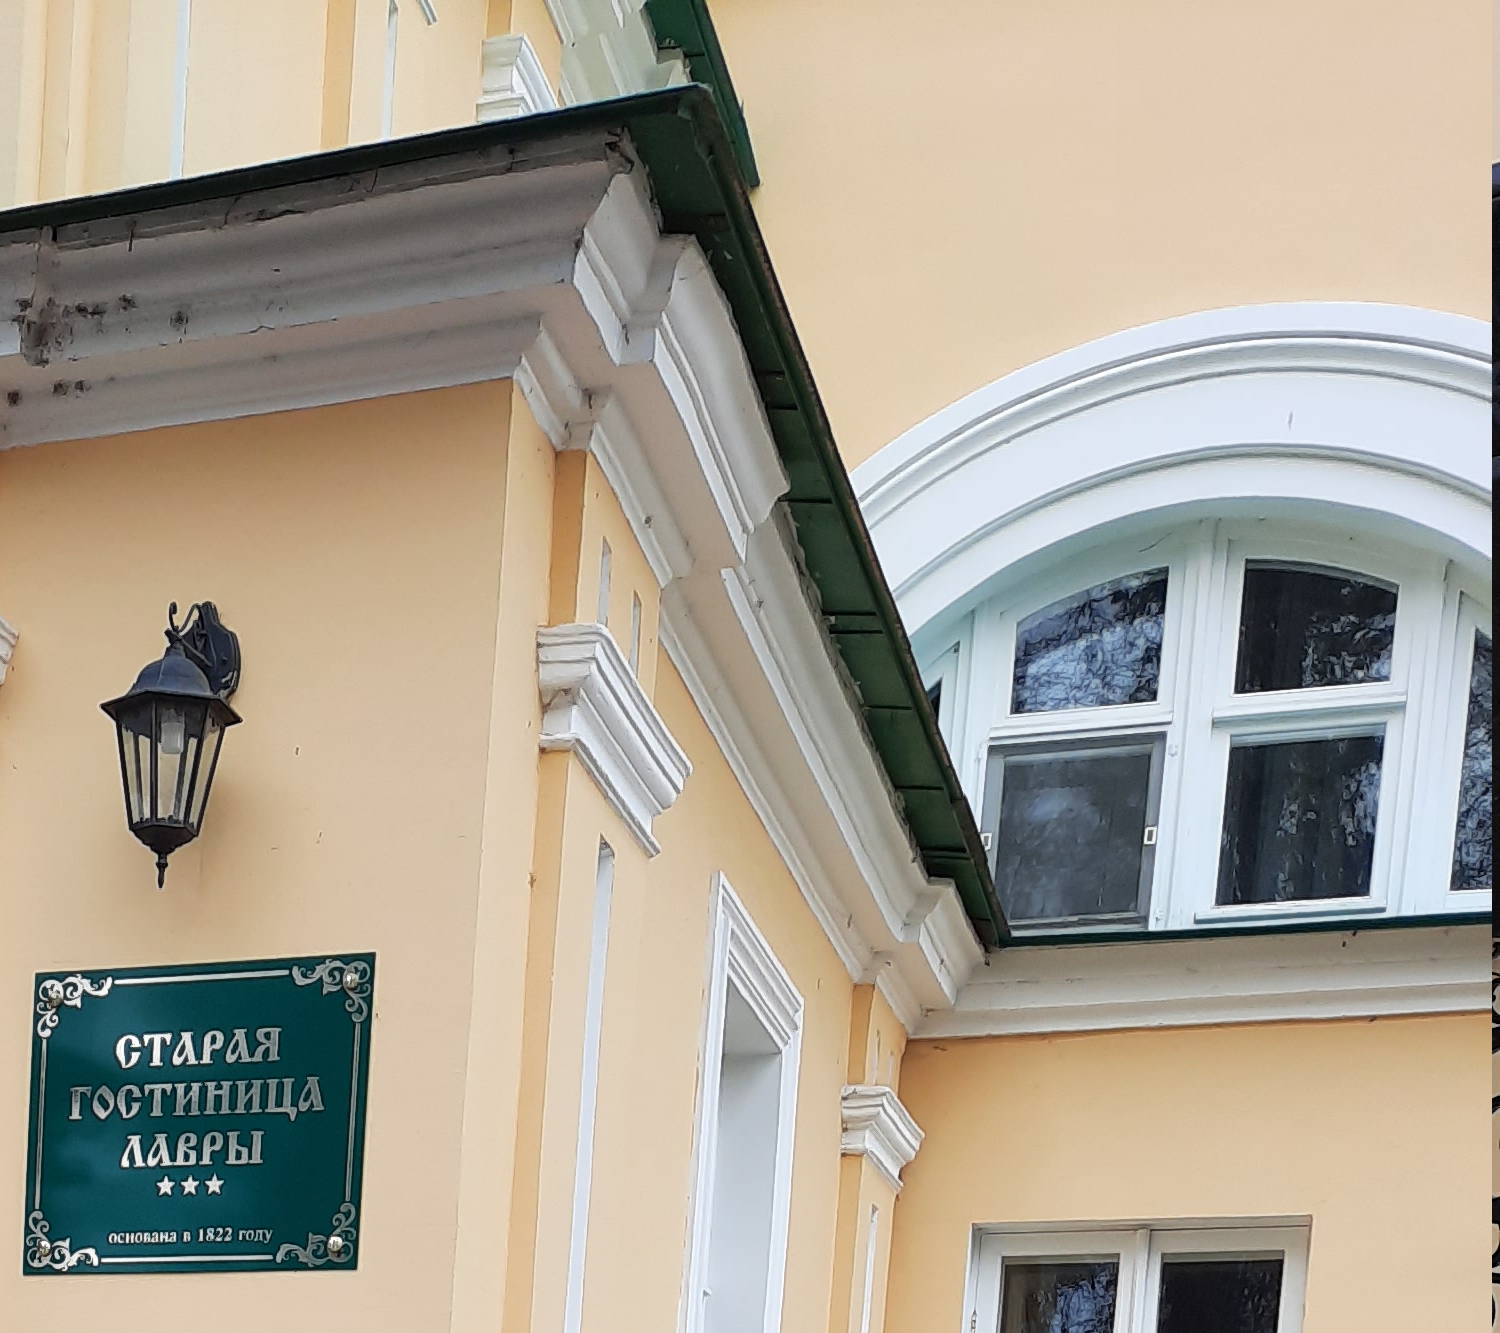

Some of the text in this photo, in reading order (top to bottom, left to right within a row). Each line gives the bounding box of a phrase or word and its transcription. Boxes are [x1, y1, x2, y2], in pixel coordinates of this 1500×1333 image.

[115, 1027, 282, 1069] СТАРАЯ
[68, 1076, 325, 1121] ГОСТИНИЦА
[120, 1130, 265, 1168] ЛАВРЫ
[108, 1227, 274, 1245] основана в 1822 году
